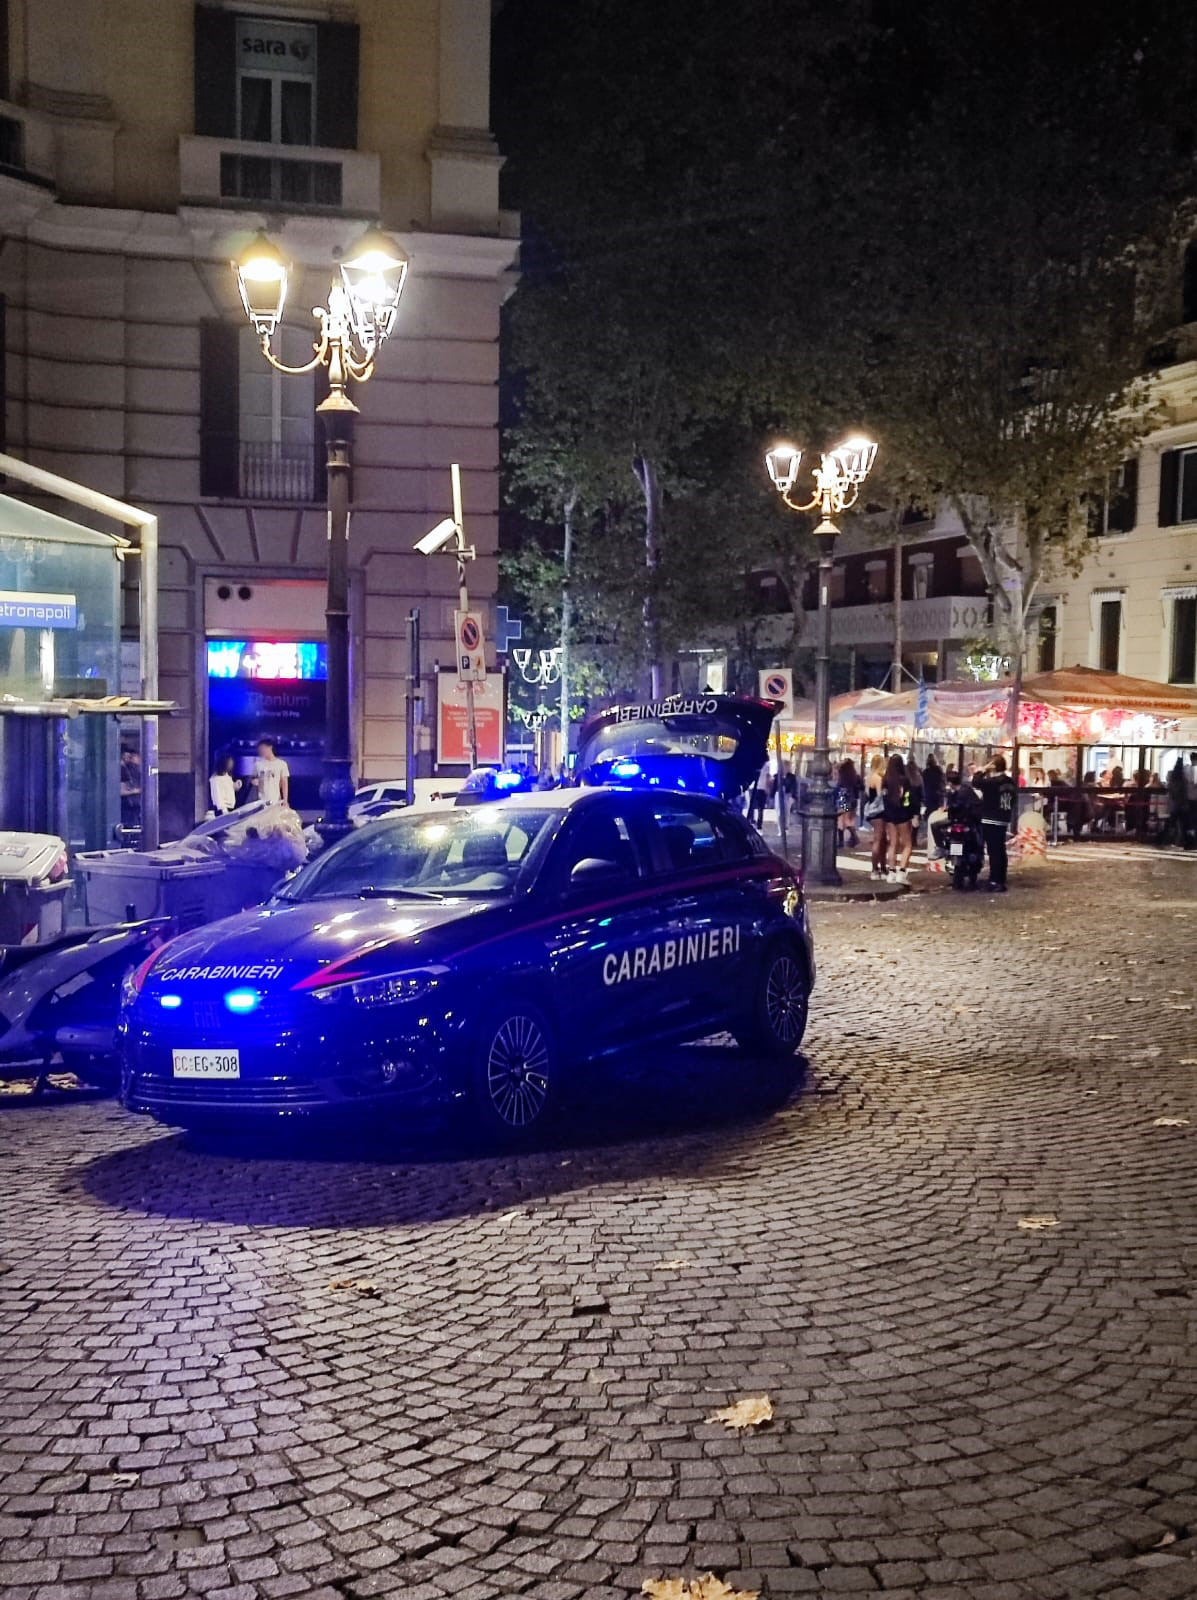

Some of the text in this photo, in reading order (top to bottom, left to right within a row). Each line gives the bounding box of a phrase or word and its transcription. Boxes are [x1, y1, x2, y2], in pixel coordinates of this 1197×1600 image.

[242, 37, 286, 56] sara
[614, 699, 718, 723] CARABINIERI
[602, 923, 740, 986] CARABINIERI
[160, 965, 284, 981] CARABINIERI
